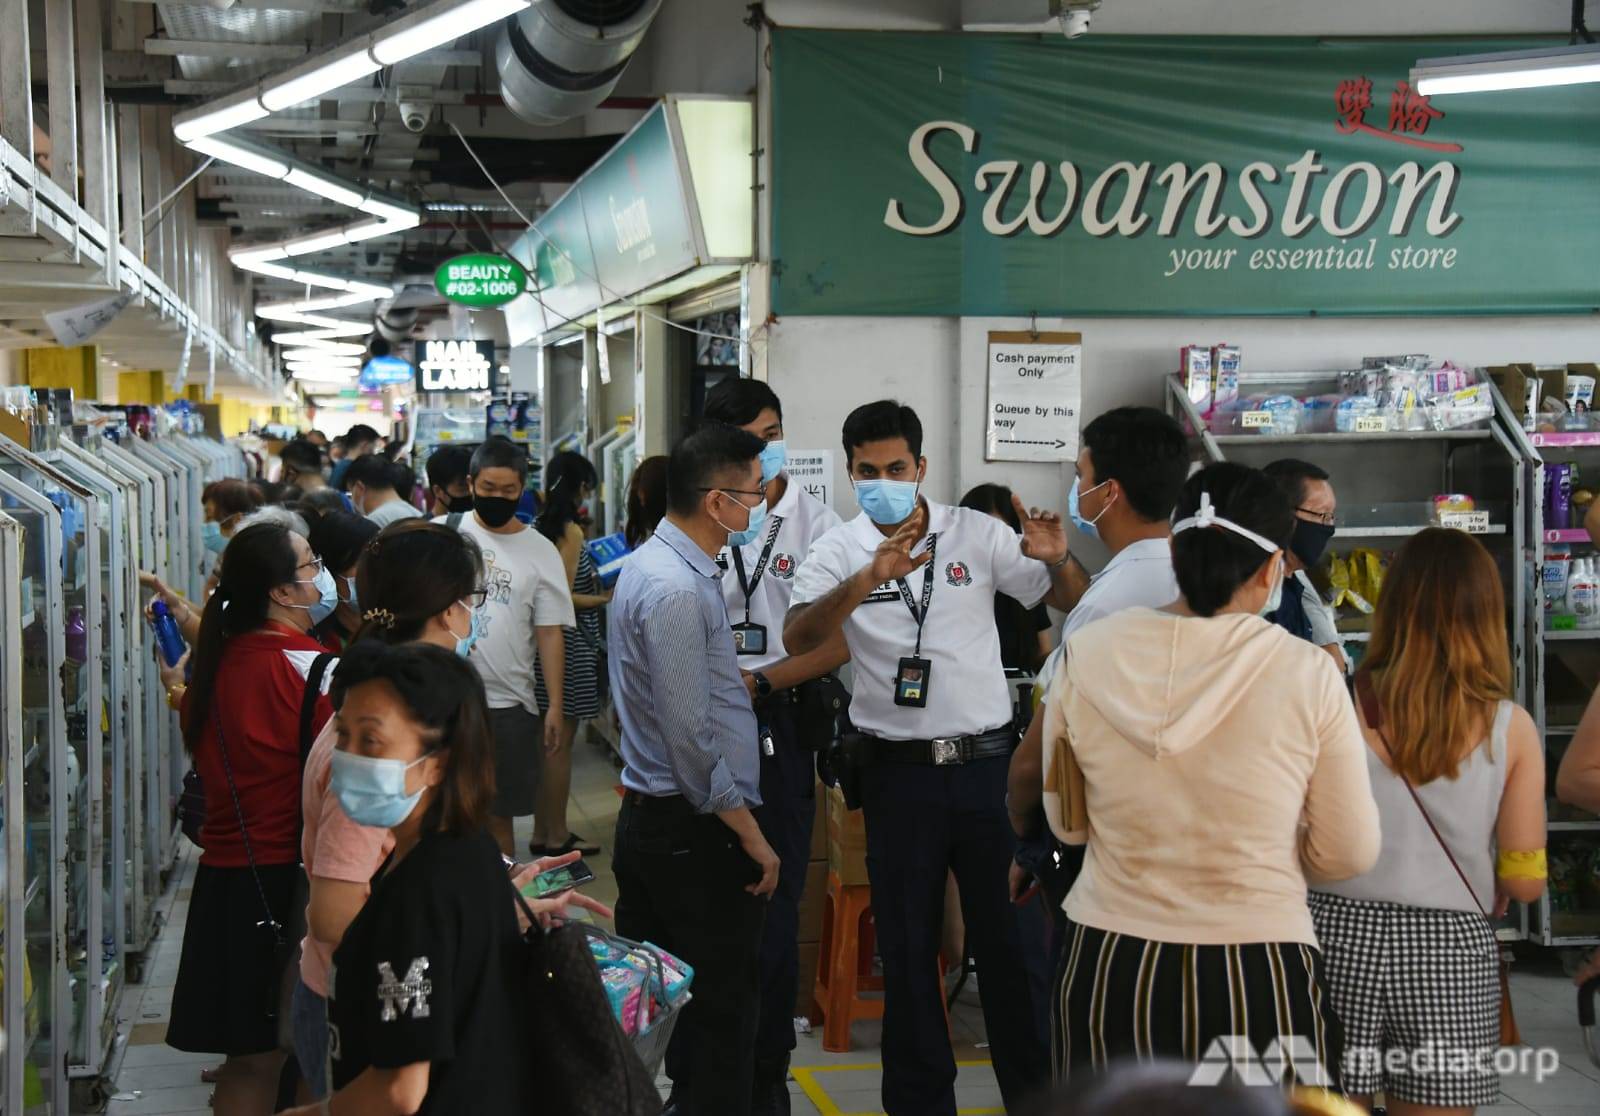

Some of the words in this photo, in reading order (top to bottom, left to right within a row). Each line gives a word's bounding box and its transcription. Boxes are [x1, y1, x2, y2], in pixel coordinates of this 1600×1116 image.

[884, 120, 1462, 238] Swanston
[1164, 247, 1237, 277] your
[1249, 238, 1377, 270] essential
[1388, 245, 1458, 270] store
[448, 264, 511, 280] BEAUTY
[446, 281, 517, 296] #02-1006
[996, 352, 1024, 363] Cash
[1027, 354, 1075, 365] payment
[1018, 367, 1044, 379] Only
[994, 403, 1031, 415] Queue
[1035, 405, 1049, 418] by
[1053, 407, 1074, 417] this
[994, 419, 1016, 430] way
